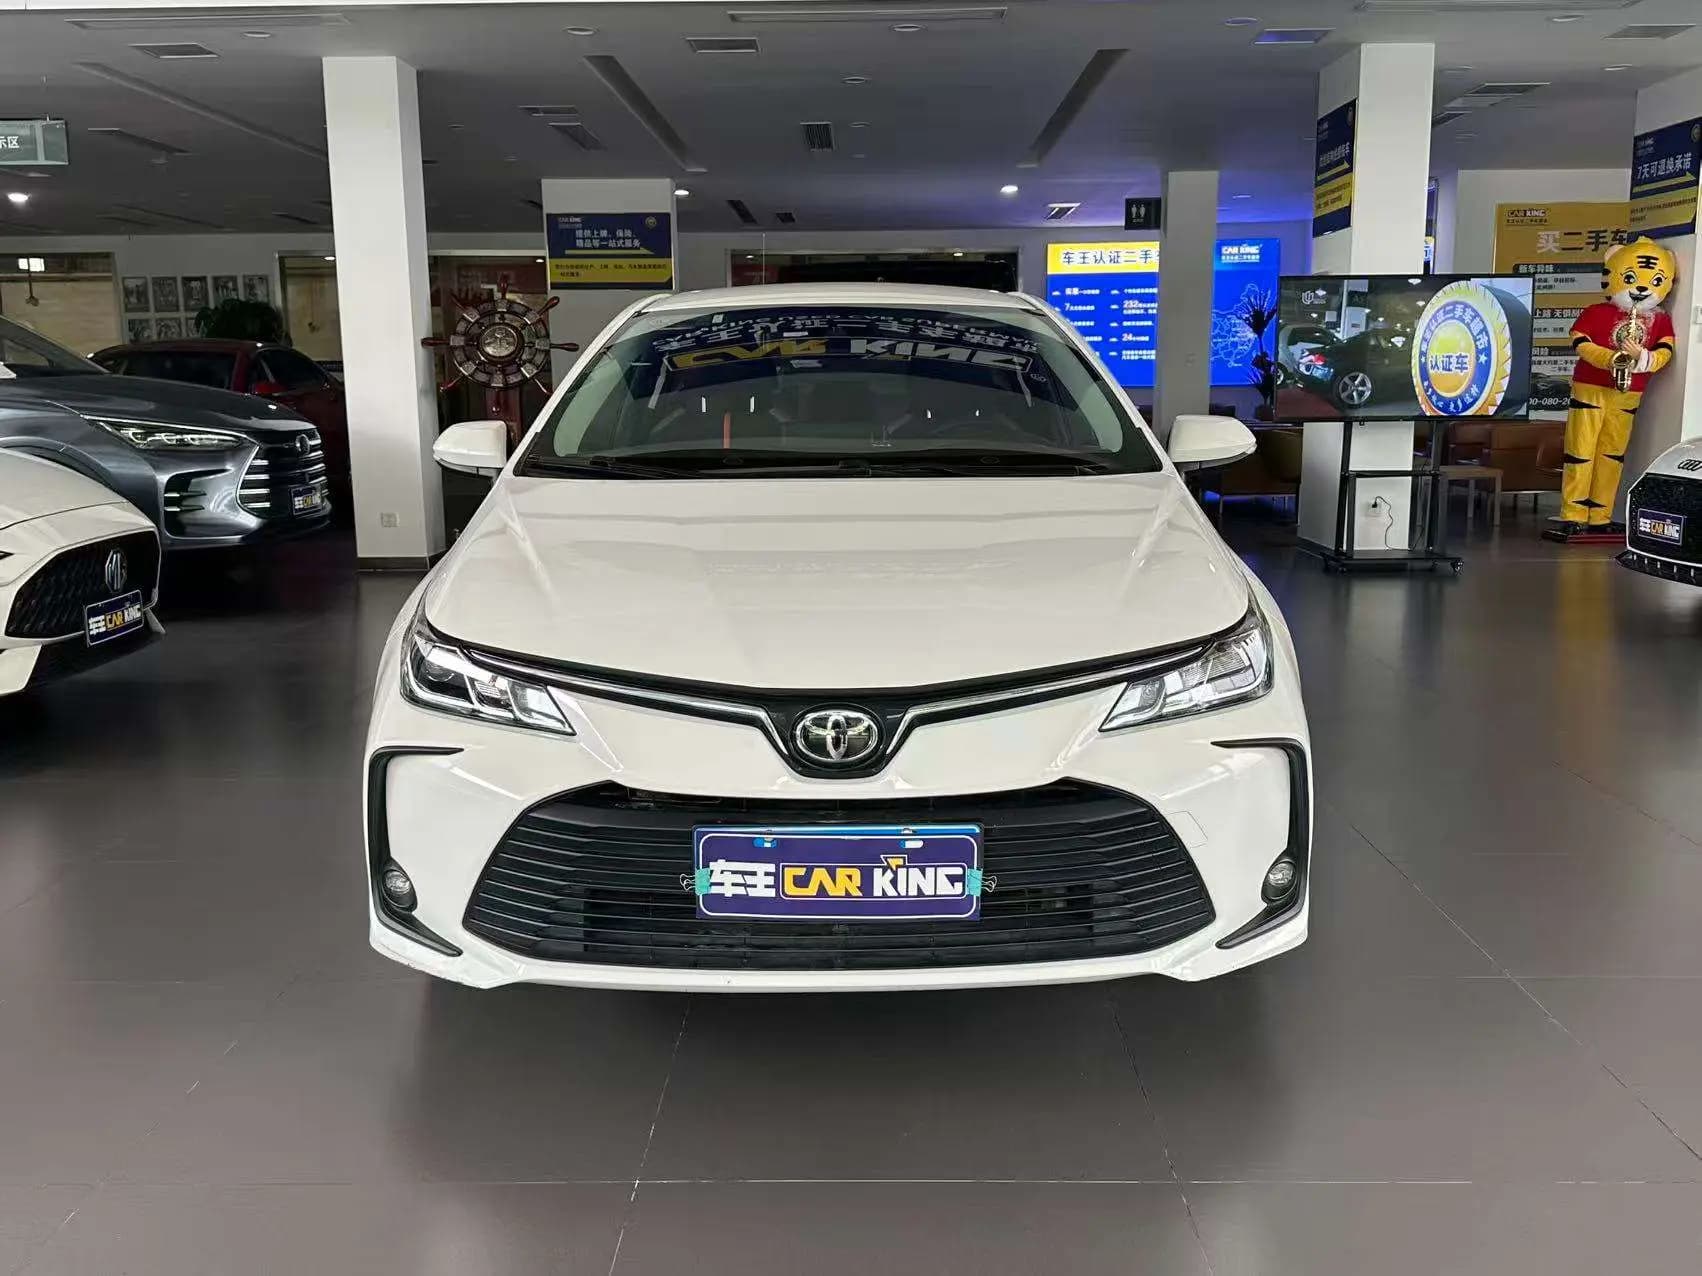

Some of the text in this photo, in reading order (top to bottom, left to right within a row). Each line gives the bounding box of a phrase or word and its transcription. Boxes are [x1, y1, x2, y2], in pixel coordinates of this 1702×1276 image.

[1537, 229, 1627, 253] 买二手车
[1062, 249, 1159, 264] 车王认证二手
[1430, 354, 1469, 373] 认证车
[106, 611, 124, 629] CAR
[124, 604, 141, 623] KING
[709, 859, 963, 897] 车王 CAR KING
